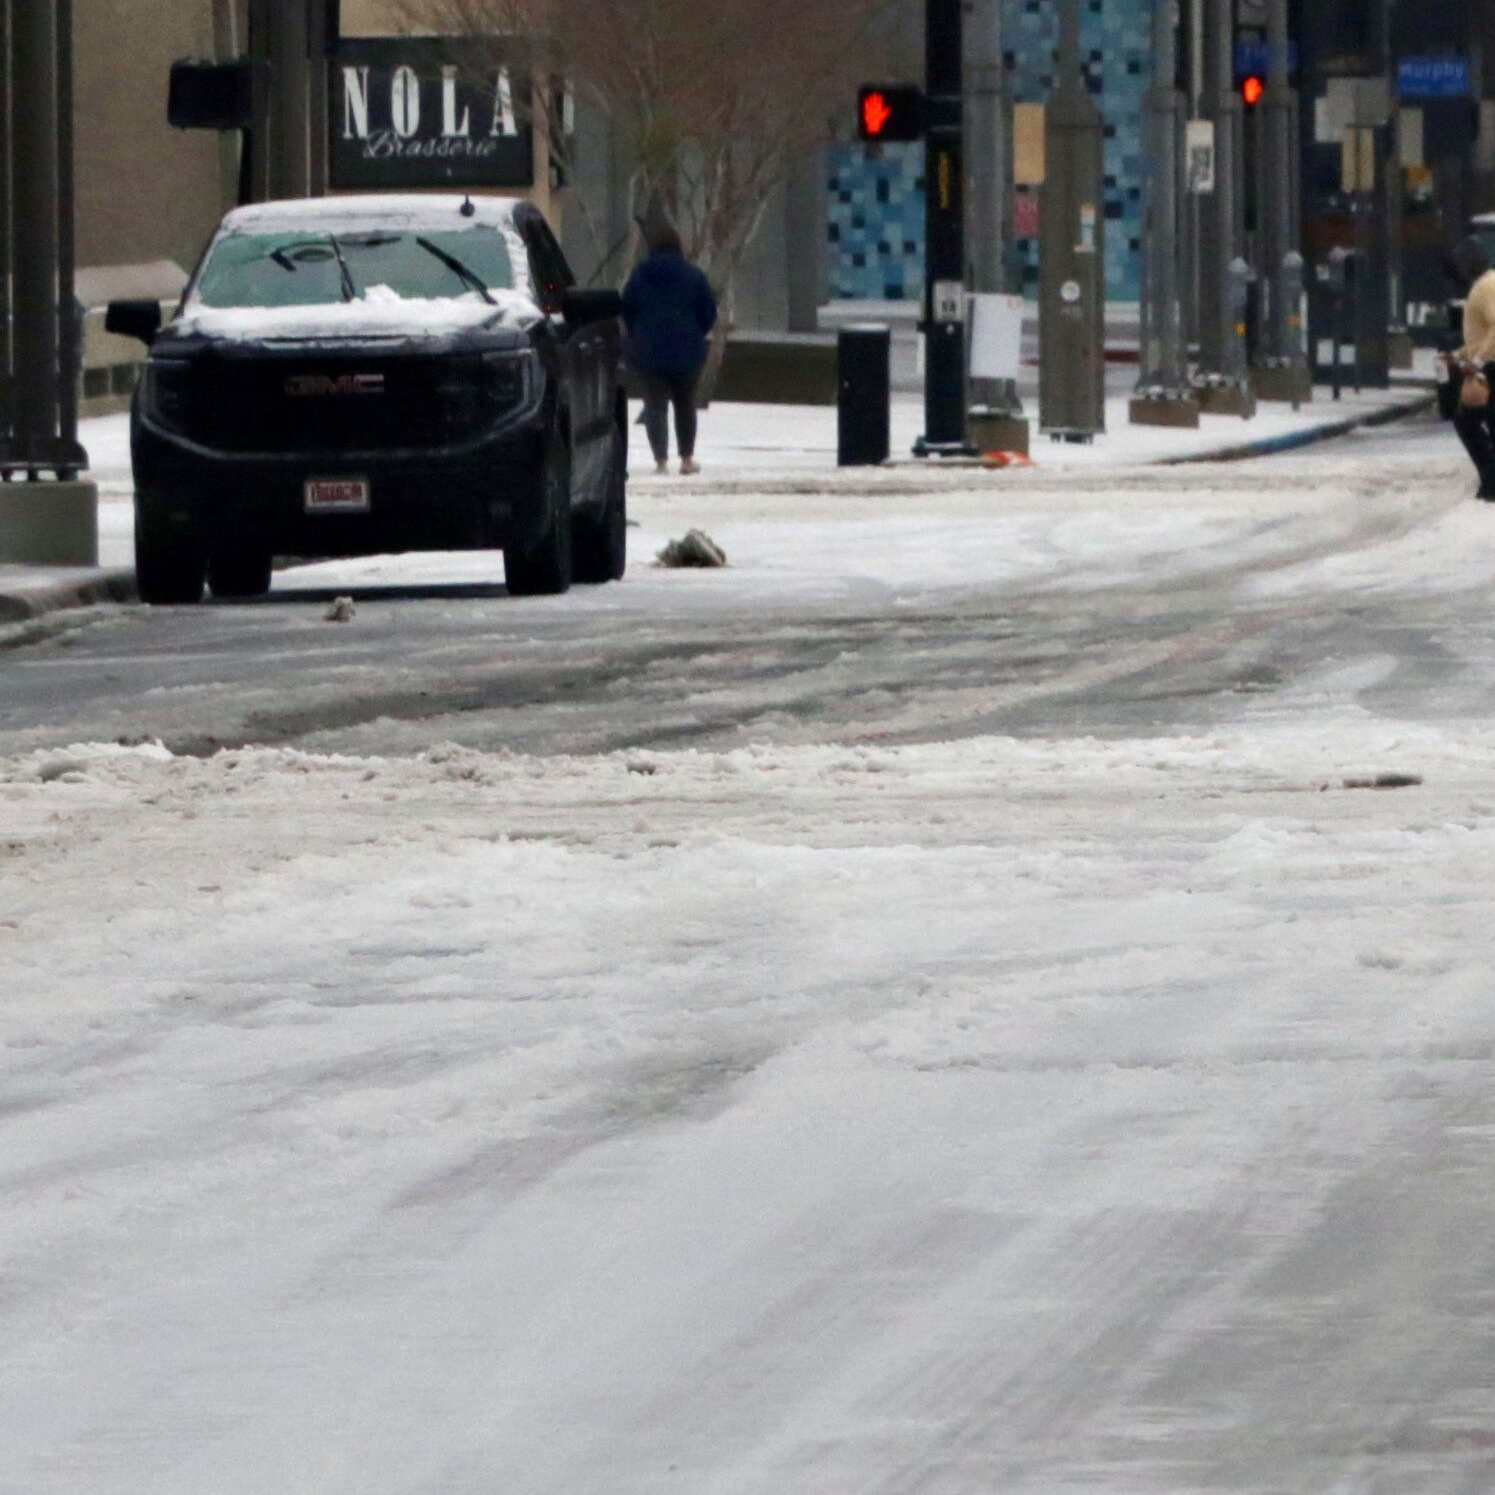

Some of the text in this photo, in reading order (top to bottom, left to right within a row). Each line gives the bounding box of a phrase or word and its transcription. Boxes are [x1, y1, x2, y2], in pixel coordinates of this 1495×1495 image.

[342, 64, 518, 138] NOLA
[362, 128, 497, 159] Brasserie
[284, 374, 385, 394] GMC
